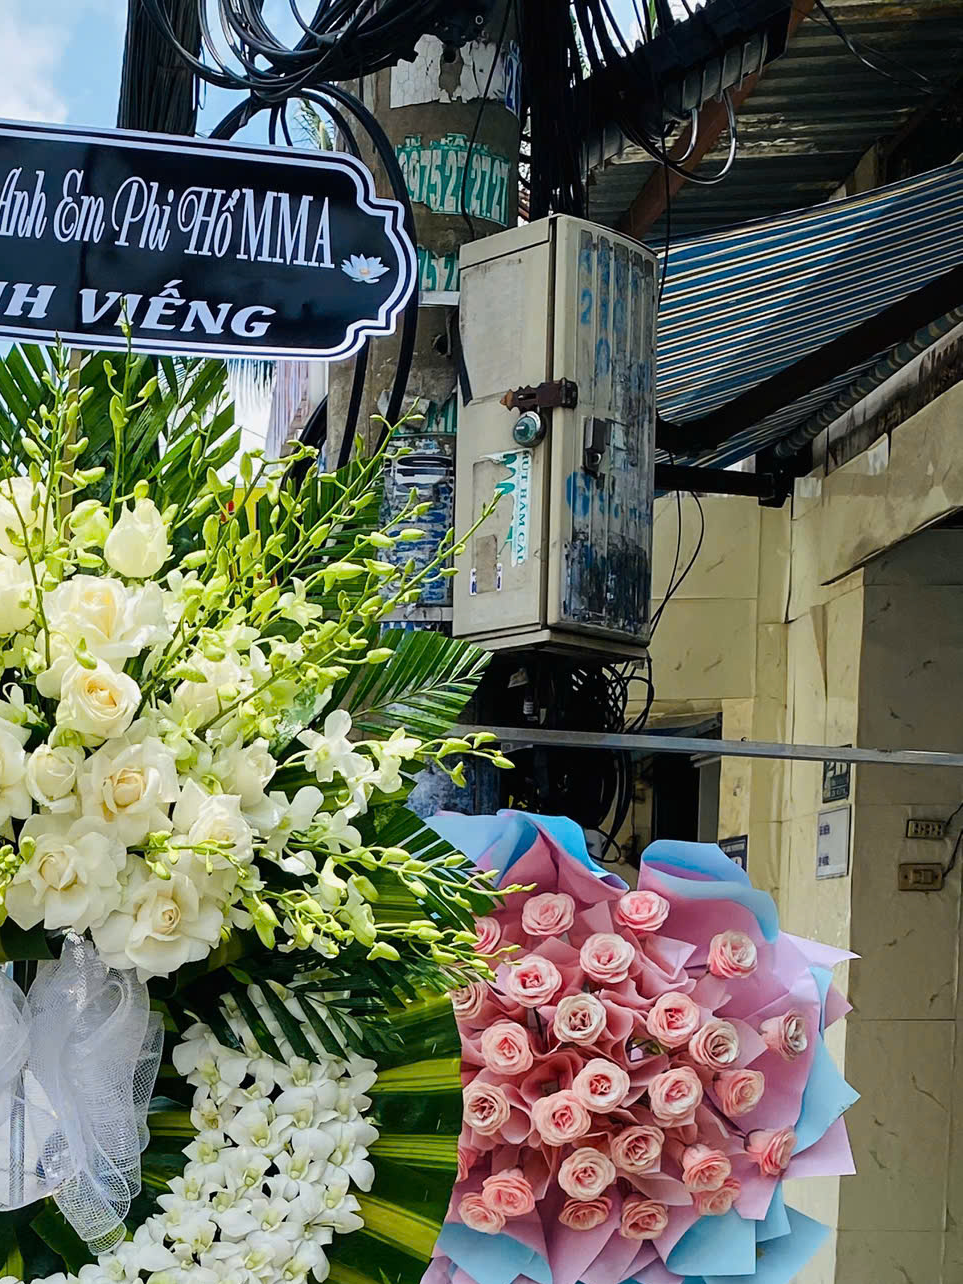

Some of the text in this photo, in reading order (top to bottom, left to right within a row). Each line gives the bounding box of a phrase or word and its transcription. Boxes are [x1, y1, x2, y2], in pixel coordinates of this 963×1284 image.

[53, 169, 105, 244] Em
[112, 176, 174, 251] Phi
[177, 186, 240, 257] Hổ
[236, 188, 336, 269] MMA
[79, 279, 277, 338] VIẾNG
